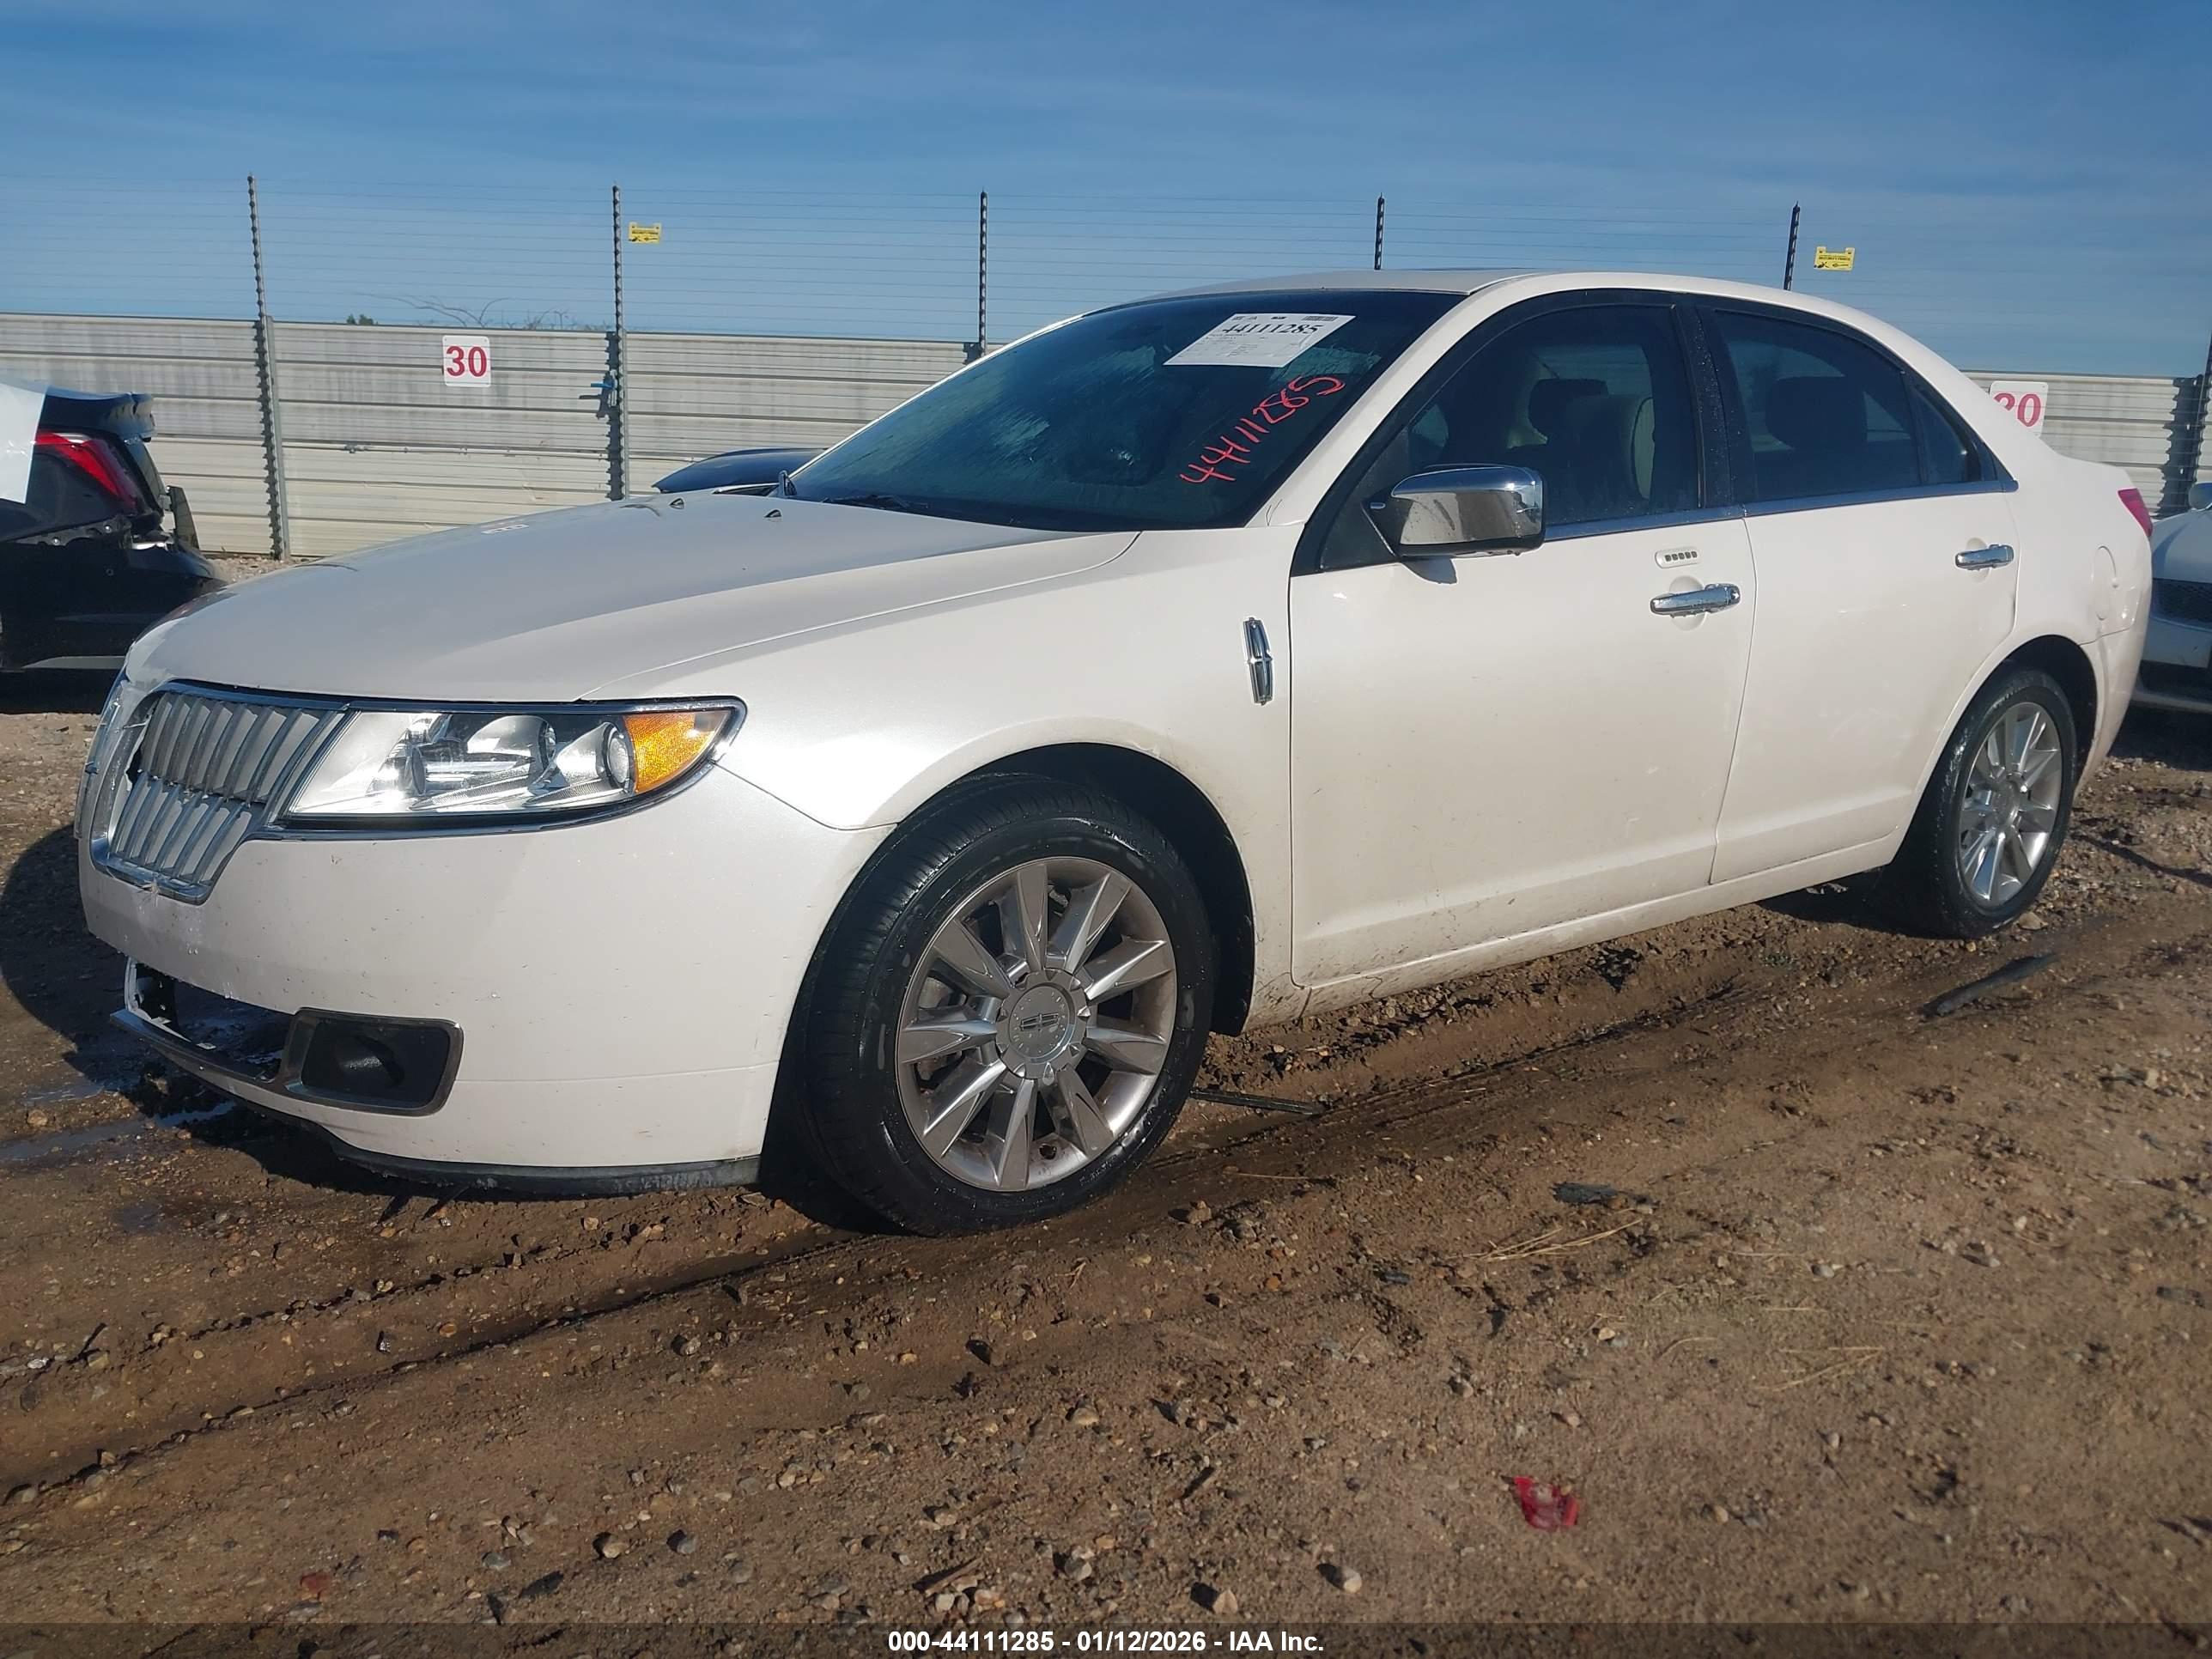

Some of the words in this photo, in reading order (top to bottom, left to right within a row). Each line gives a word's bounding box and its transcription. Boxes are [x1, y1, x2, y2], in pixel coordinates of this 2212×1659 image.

[1222, 323, 1324, 335] 44111285
[446, 345, 488, 378] 30
[1178, 376, 1346, 483] 44111285
